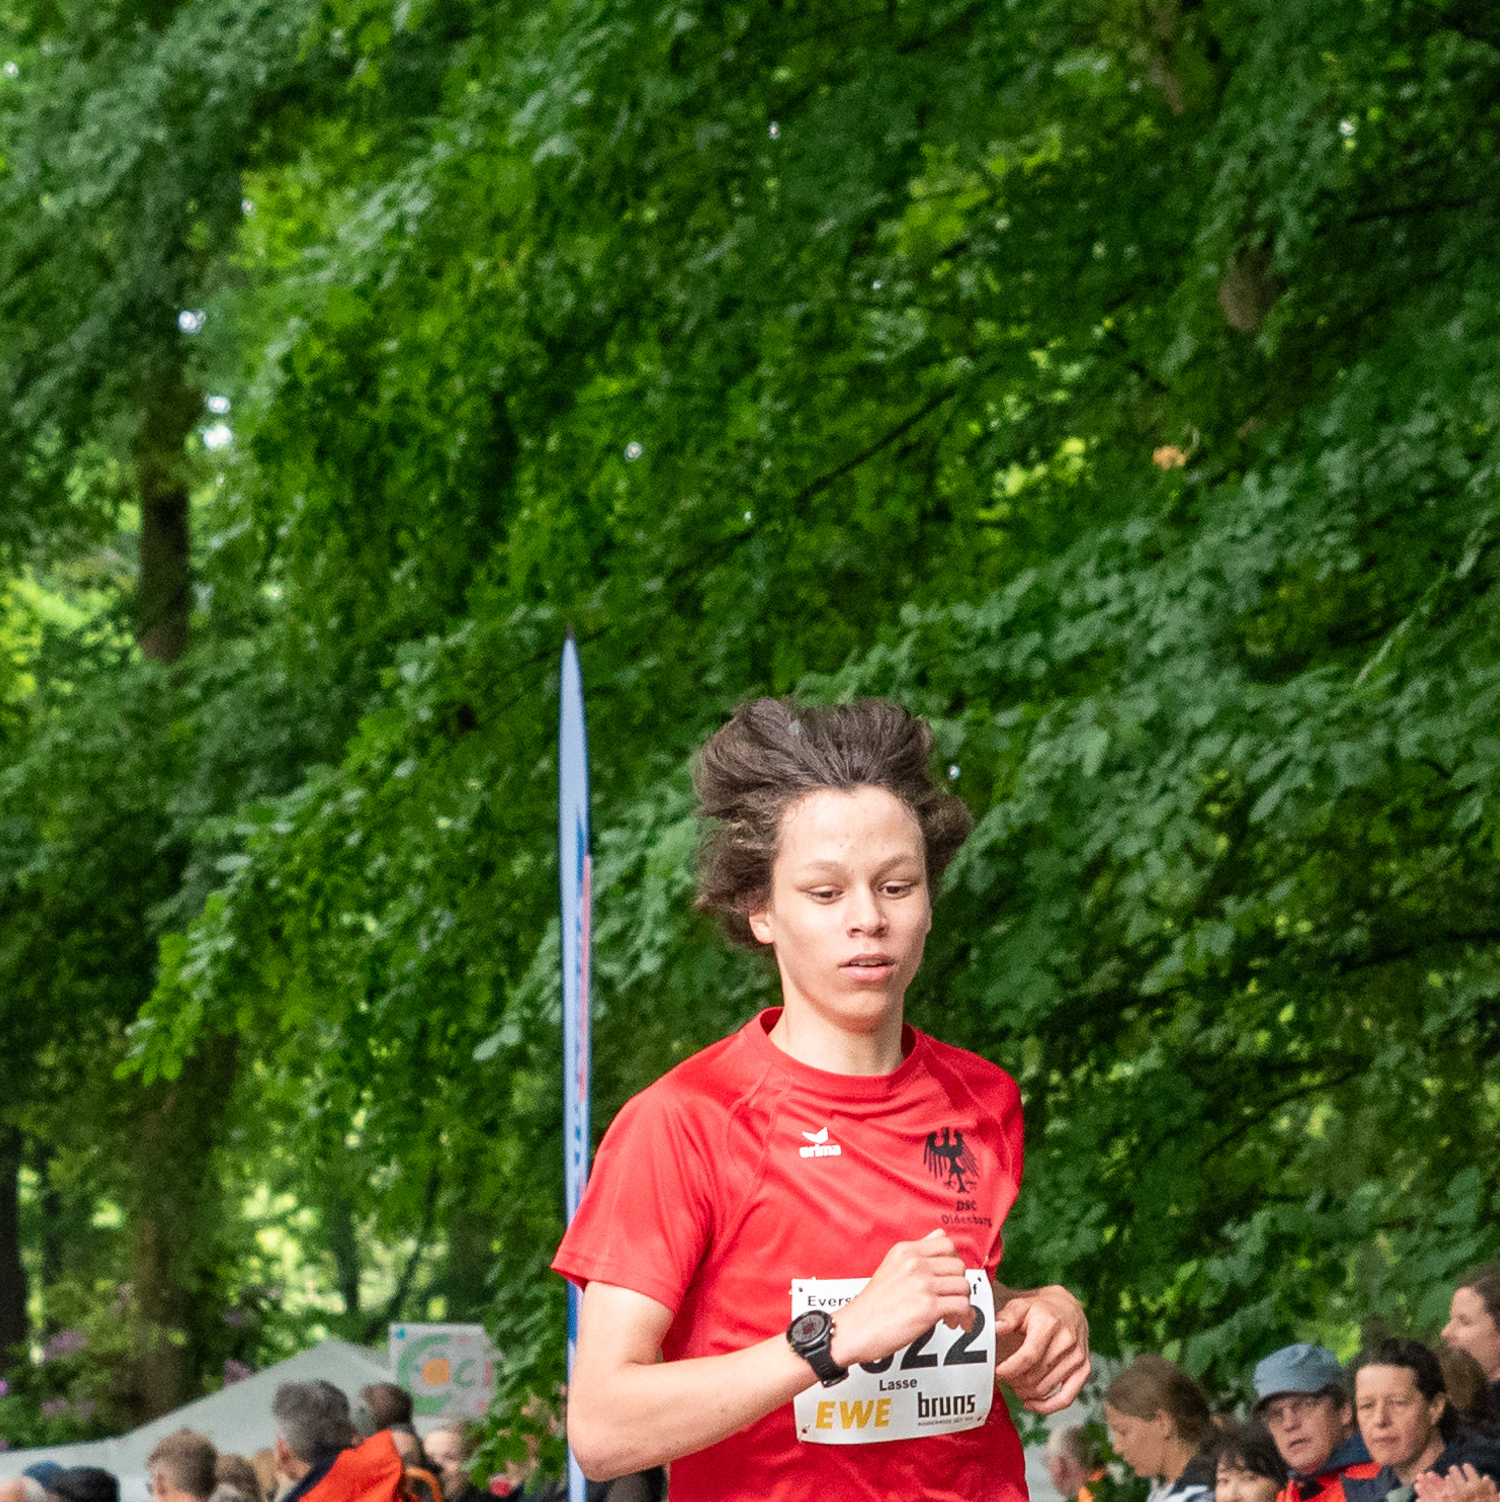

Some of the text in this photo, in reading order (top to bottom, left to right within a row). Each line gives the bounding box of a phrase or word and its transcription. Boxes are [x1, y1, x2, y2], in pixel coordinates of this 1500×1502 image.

[799, 1143, 842, 1158] erima
[956, 1200, 977, 1211] DSC
[941, 1214, 992, 1228] Oldenburg
[879, 1377, 918, 1392] Lasse
[917, 1391, 976, 1418] bruns
[815, 1398, 892, 1430] EWE
